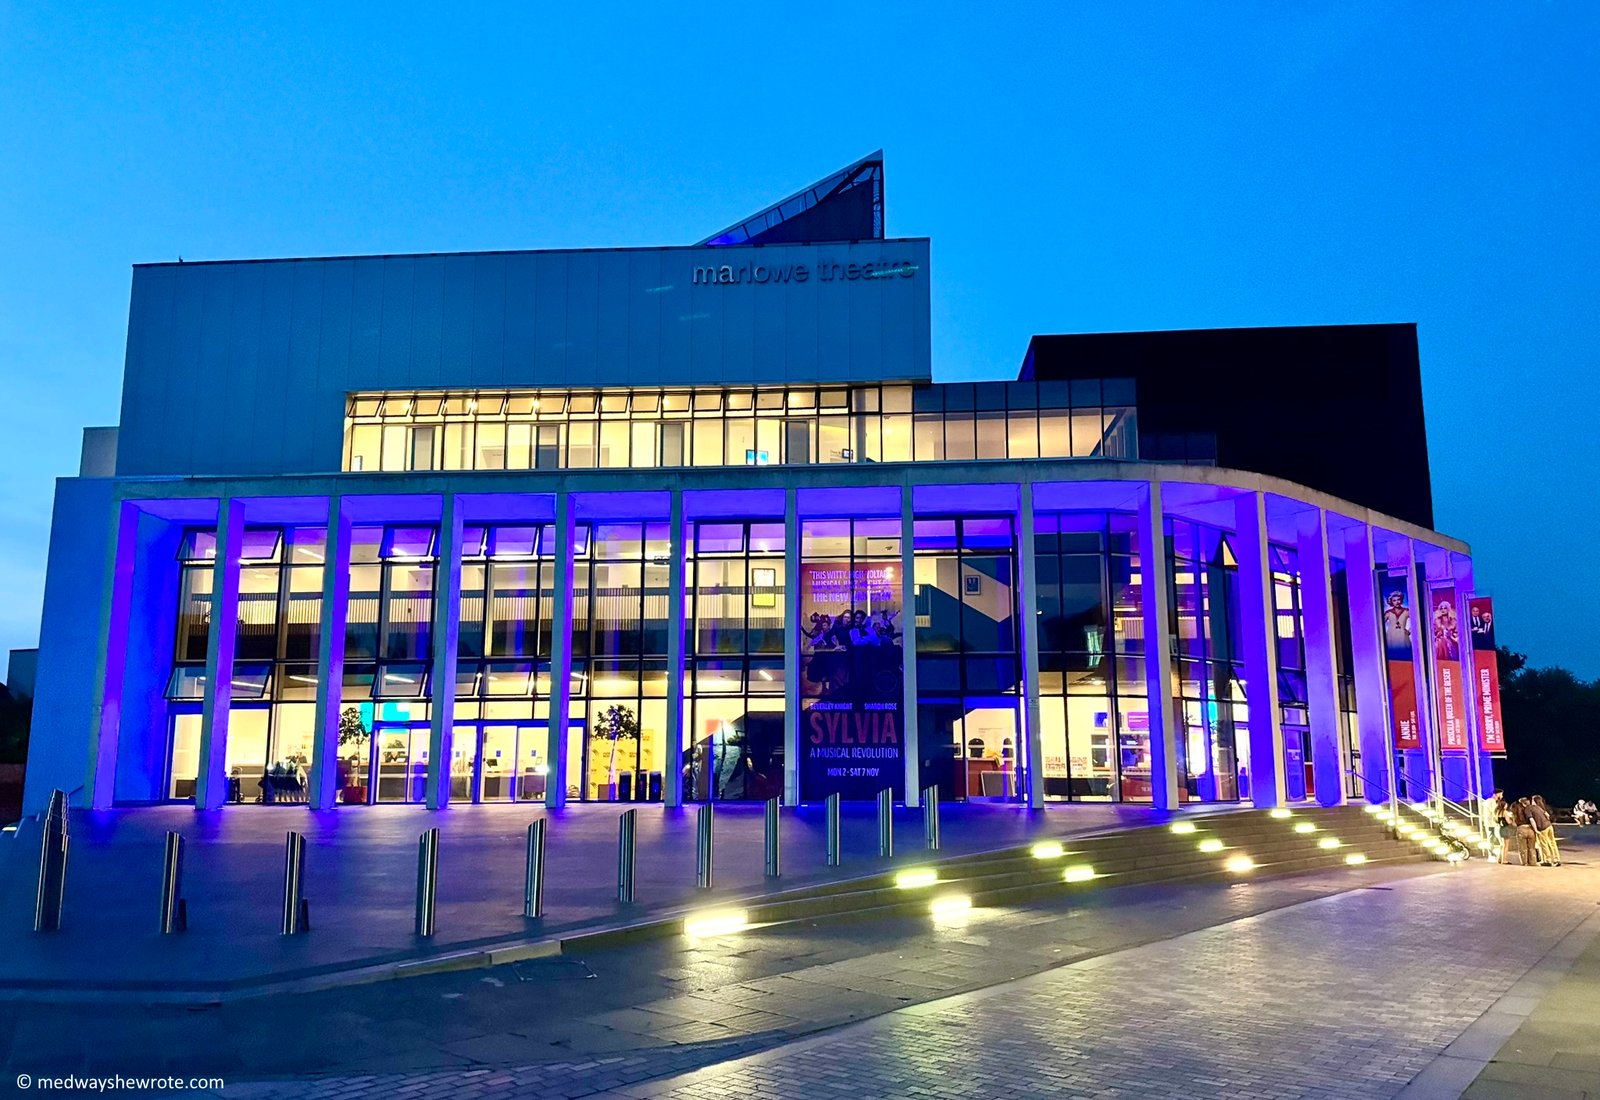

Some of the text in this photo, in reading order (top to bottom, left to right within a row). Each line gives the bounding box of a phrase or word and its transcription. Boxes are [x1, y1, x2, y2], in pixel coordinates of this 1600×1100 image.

[692, 256, 915, 285] marlowe theatre
[1442, 668, 1452, 686] DESERT
[1480, 668, 1491, 695] MINISTER
[1444, 686, 1453, 696] THE
[884, 702, 898, 710] ROSE
[1445, 703, 1455, 720] QUEEN
[1482, 696, 1493, 714] PRIME
[810, 711, 898, 744] SYLVIA
[1400, 720, 1411, 740] ANNIE
[1446, 720, 1456, 745] PRISCILLA
[1484, 714, 1495, 734] SORRY,
[809, 747, 899, 758] A MUSICAL REVOLUTION
[827, 767, 841, 777] MON
[866, 767, 880, 777] NOV
